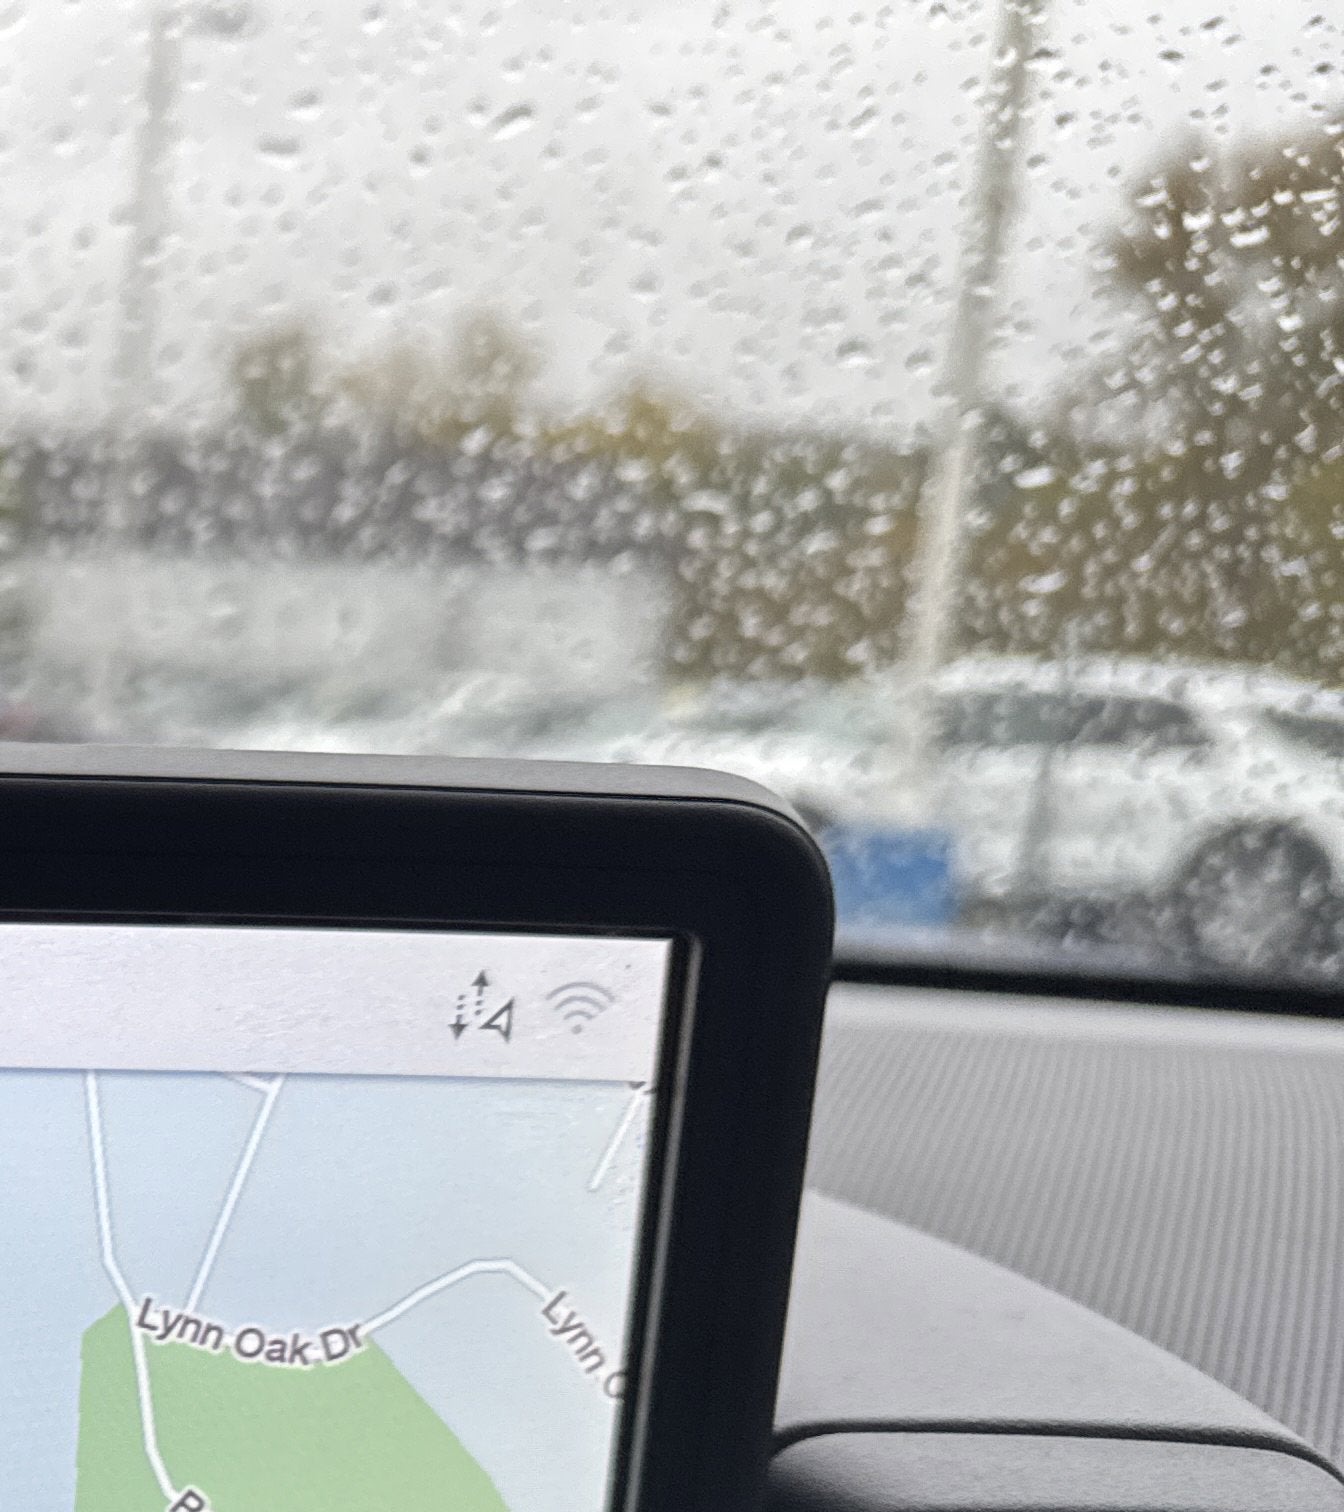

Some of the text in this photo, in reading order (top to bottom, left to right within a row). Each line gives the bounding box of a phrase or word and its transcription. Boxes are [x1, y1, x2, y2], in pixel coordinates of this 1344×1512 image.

[136, 1297, 363, 1366] Lynn Oak Dr
[541, 1290, 607, 1374] Lynn
